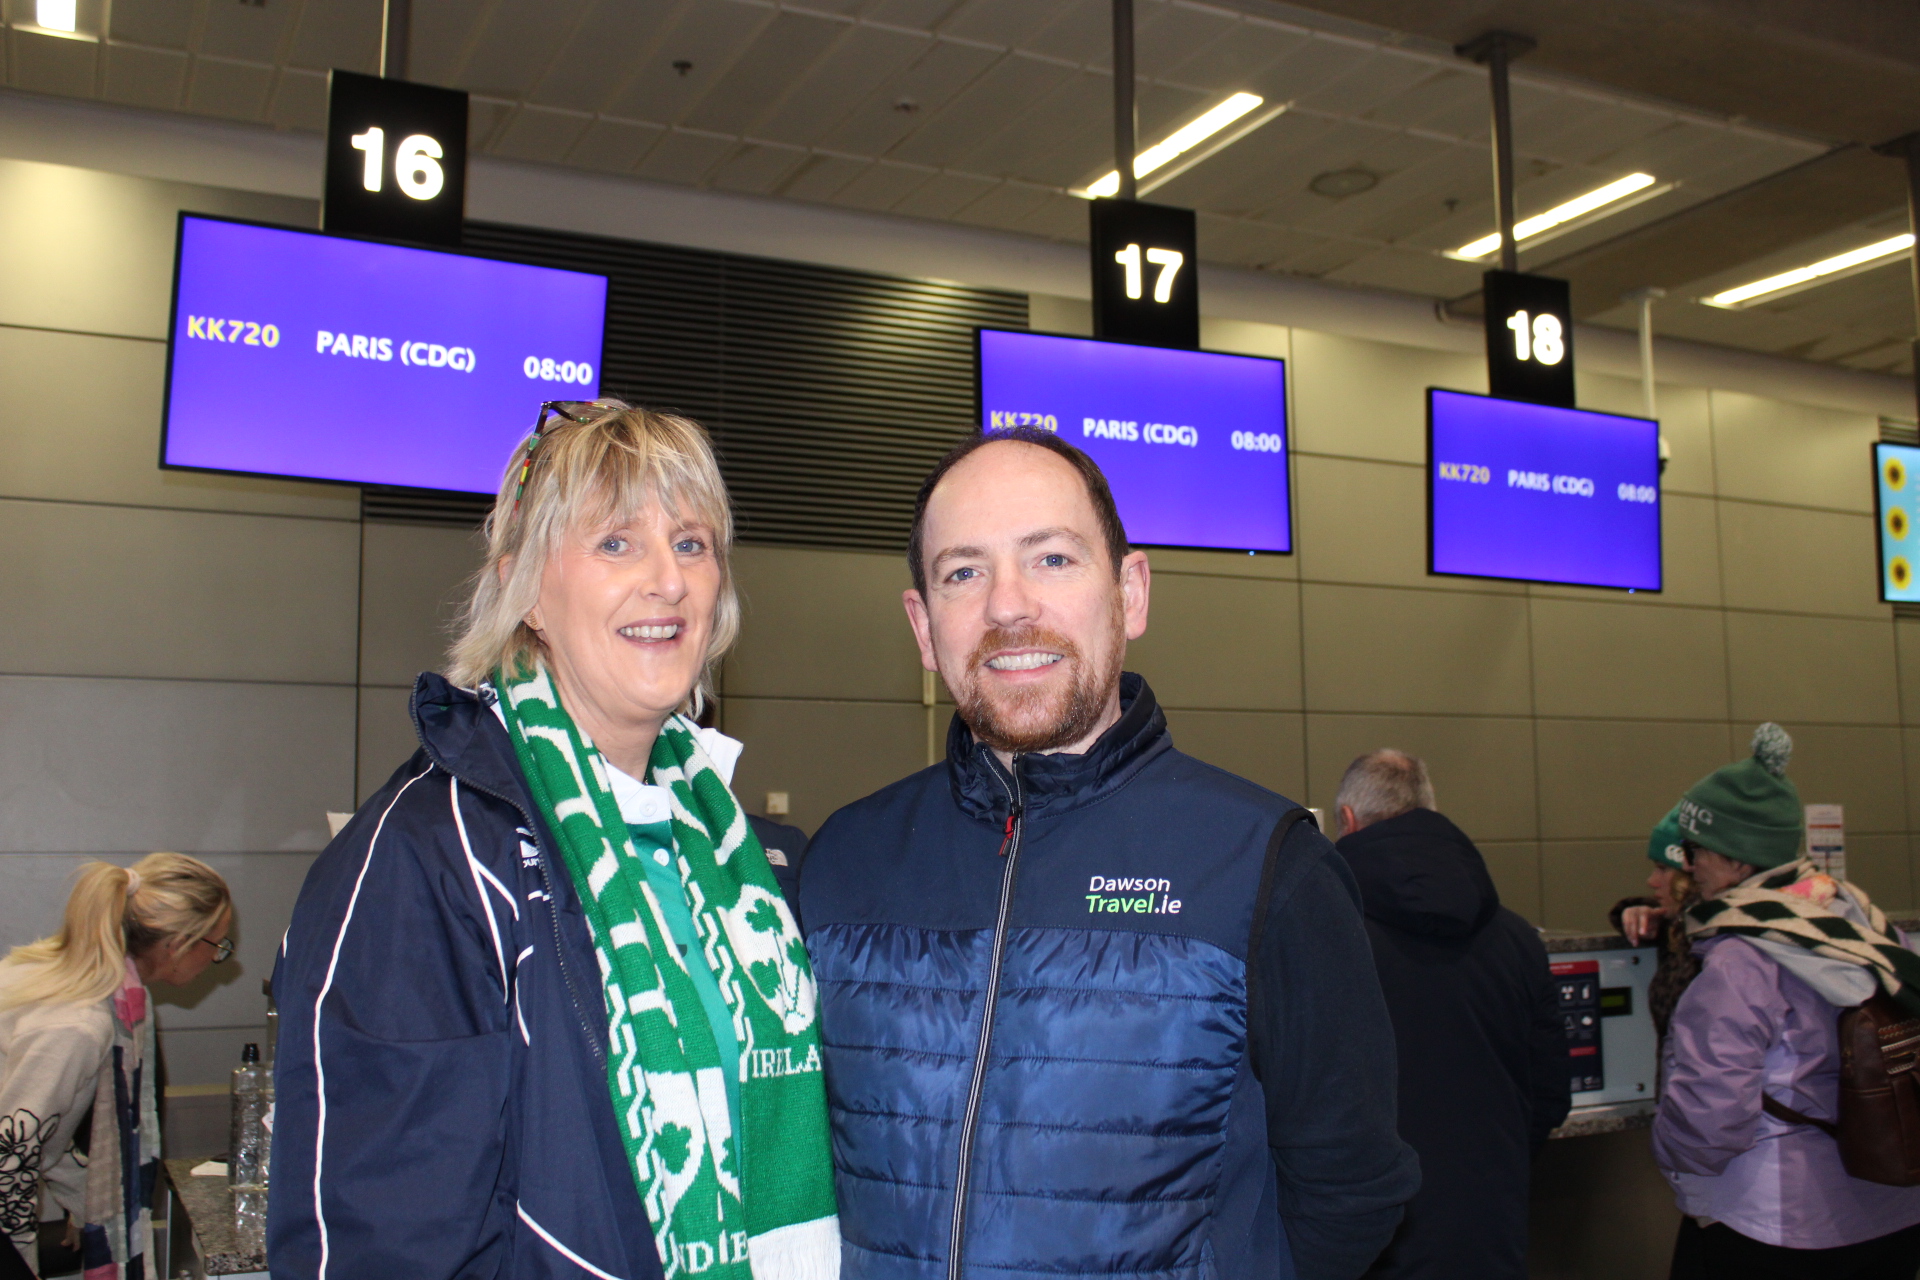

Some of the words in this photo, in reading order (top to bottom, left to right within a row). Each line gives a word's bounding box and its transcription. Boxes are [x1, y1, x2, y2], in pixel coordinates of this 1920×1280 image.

[351, 126, 445, 201] 16
[1114, 243, 1184, 304] 17
[187, 315, 281, 348] KK720
[316, 330, 394, 362] PARIS
[400, 340, 477, 374] (CDG)
[523, 355, 594, 386] 08:00
[1506, 309, 1565, 366] 18
[1083, 417, 1140, 442] PARIS
[1143, 422, 1199, 448] (CDG)
[1230, 430, 1282, 453] 08:00
[1439, 462, 1491, 485] KK720
[1507, 469, 1550, 492] PARIS
[1552, 475, 1595, 498] (CDG)
[1617, 482, 1656, 504] 08:00
[1085, 892, 1182, 914] Travel.ie
[1089, 875, 1171, 892] Dawson
[751, 1043, 823, 1078] IRELA
